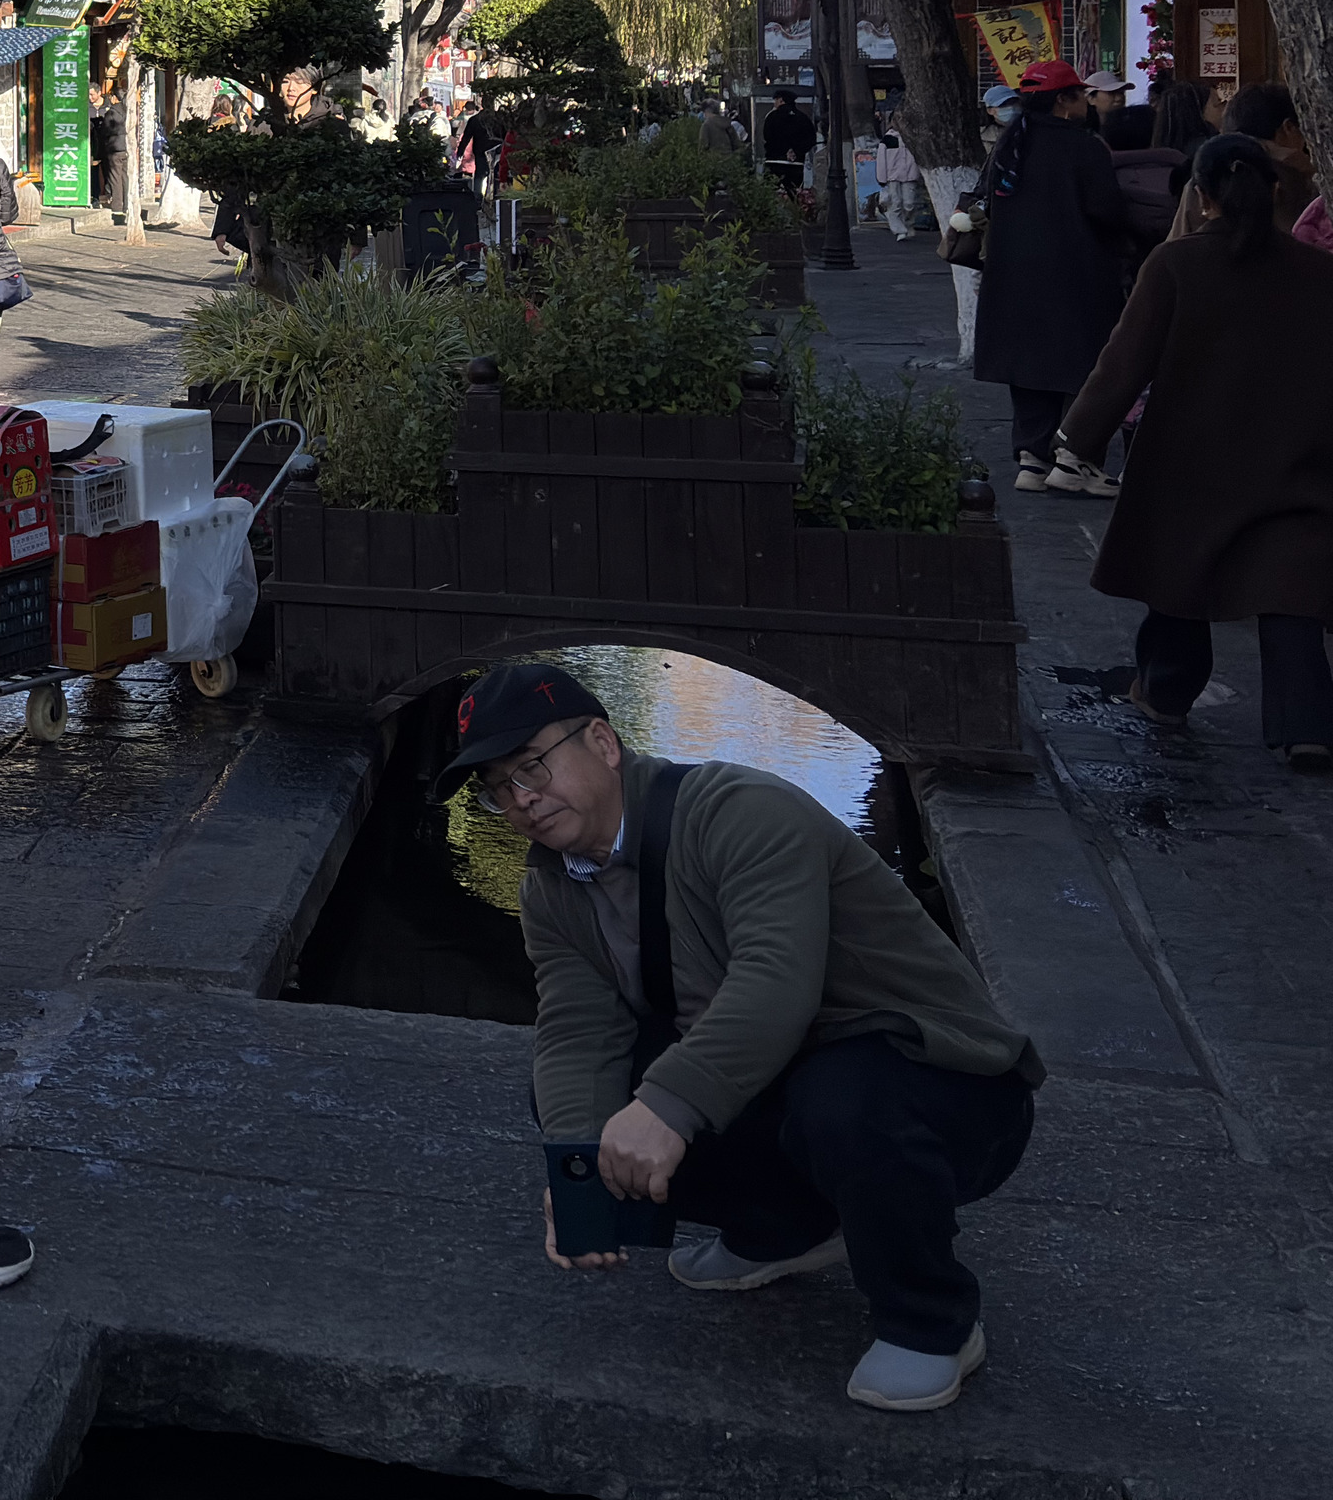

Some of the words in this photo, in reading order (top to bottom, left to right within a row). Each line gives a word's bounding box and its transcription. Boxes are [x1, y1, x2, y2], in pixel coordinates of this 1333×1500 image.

[53, 39, 79, 201] 买四送一买六送二
[14, 473, 34, 495] 芳芳
